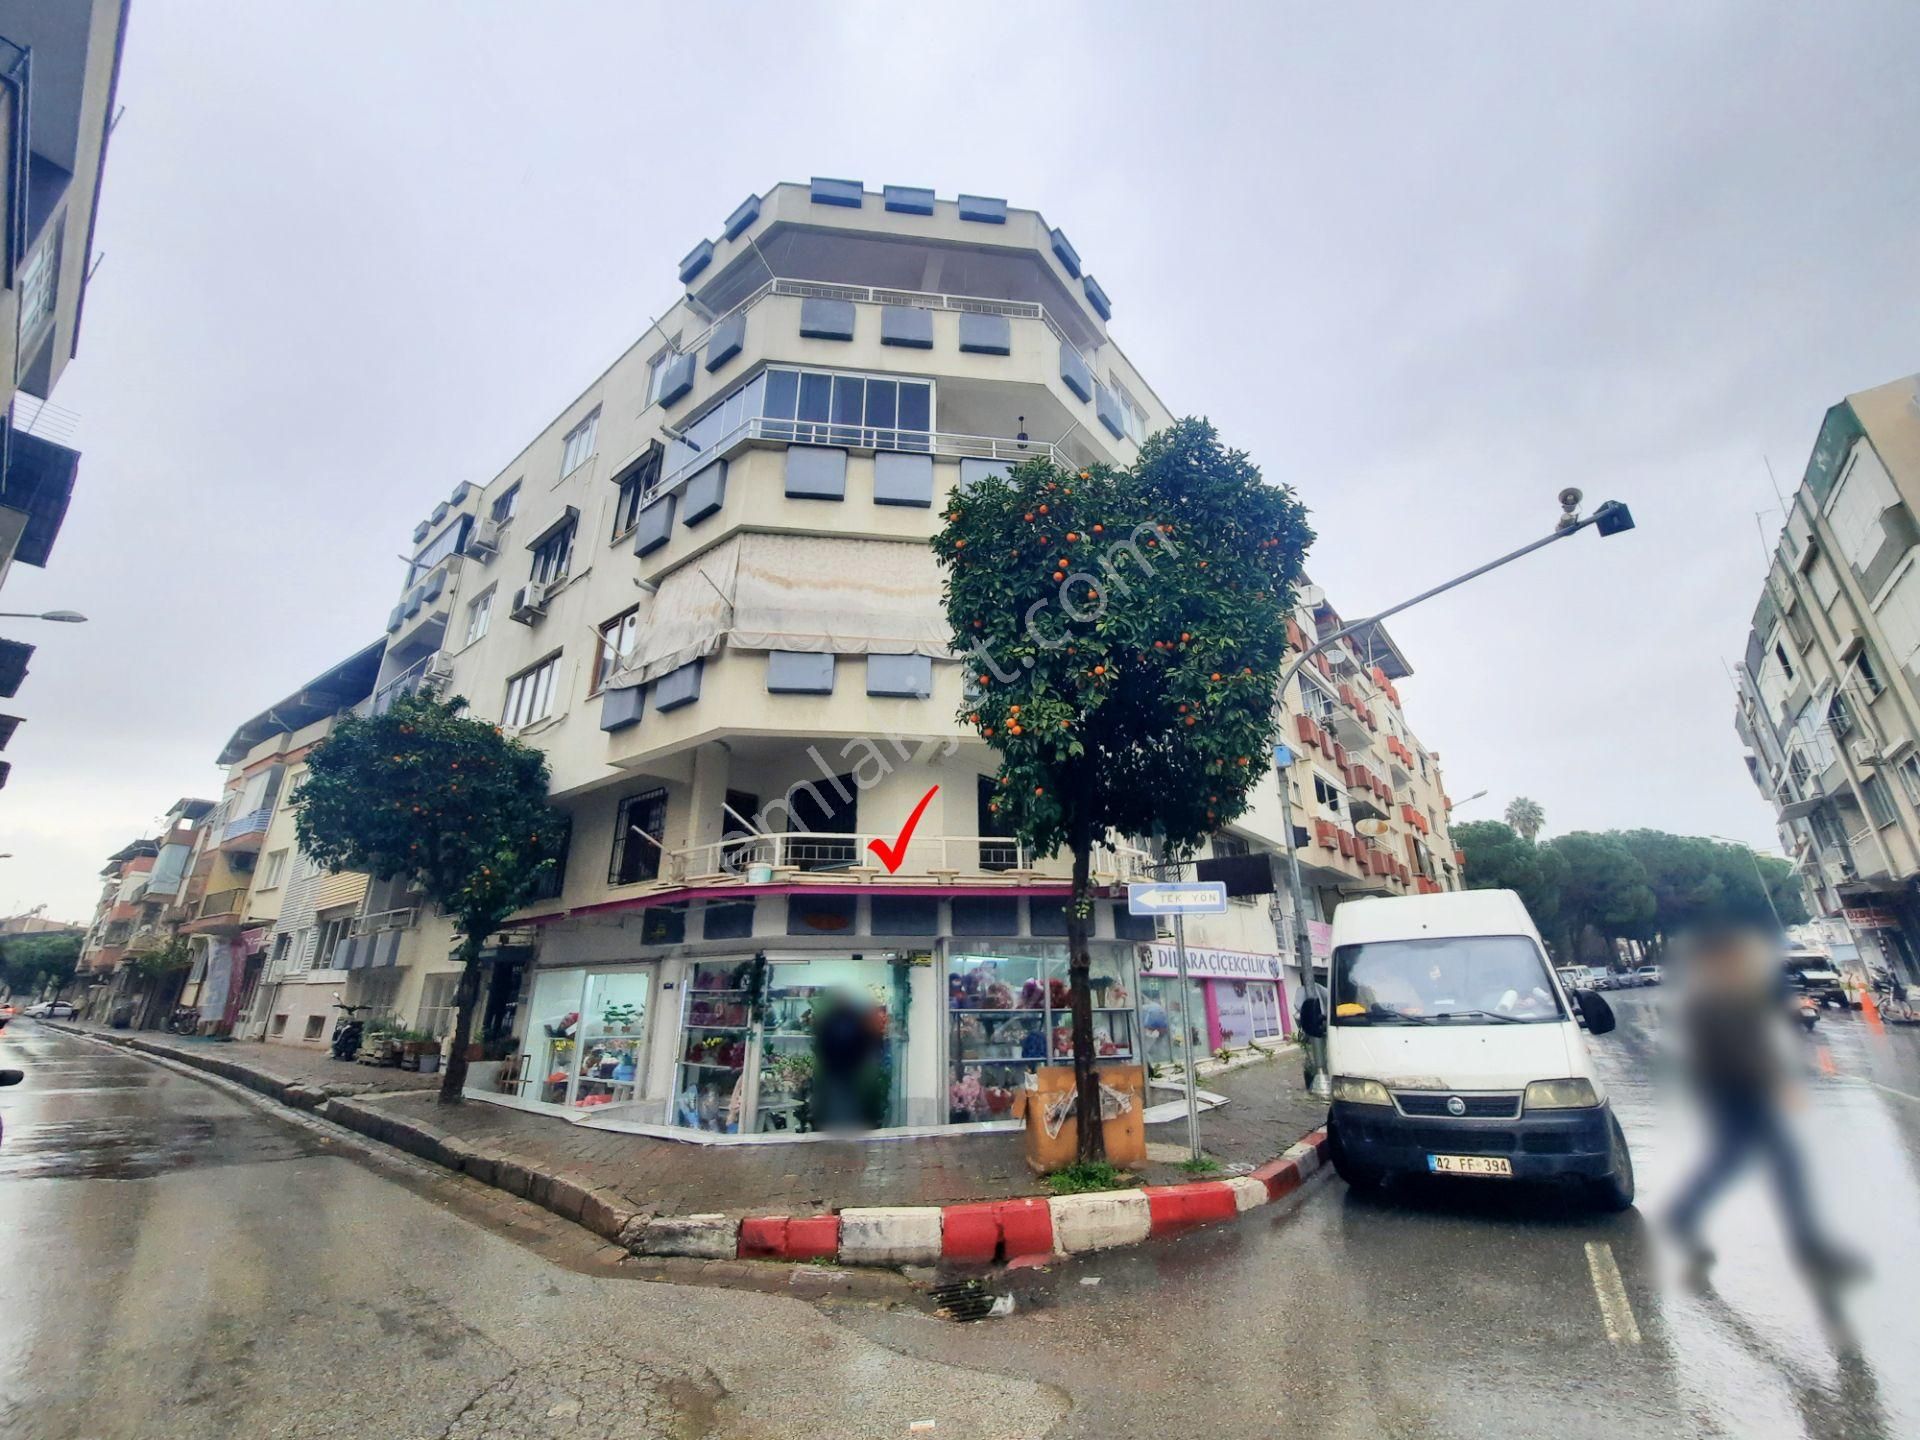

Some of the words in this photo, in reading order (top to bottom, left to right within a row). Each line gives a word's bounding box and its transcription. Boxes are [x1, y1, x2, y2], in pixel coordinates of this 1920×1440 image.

[1161, 894, 1182, 904] TEK
[1436, 1157, 1451, 1170] 42
[1459, 1158, 1474, 1170] FF
[1484, 1159, 1507, 1172] 394
